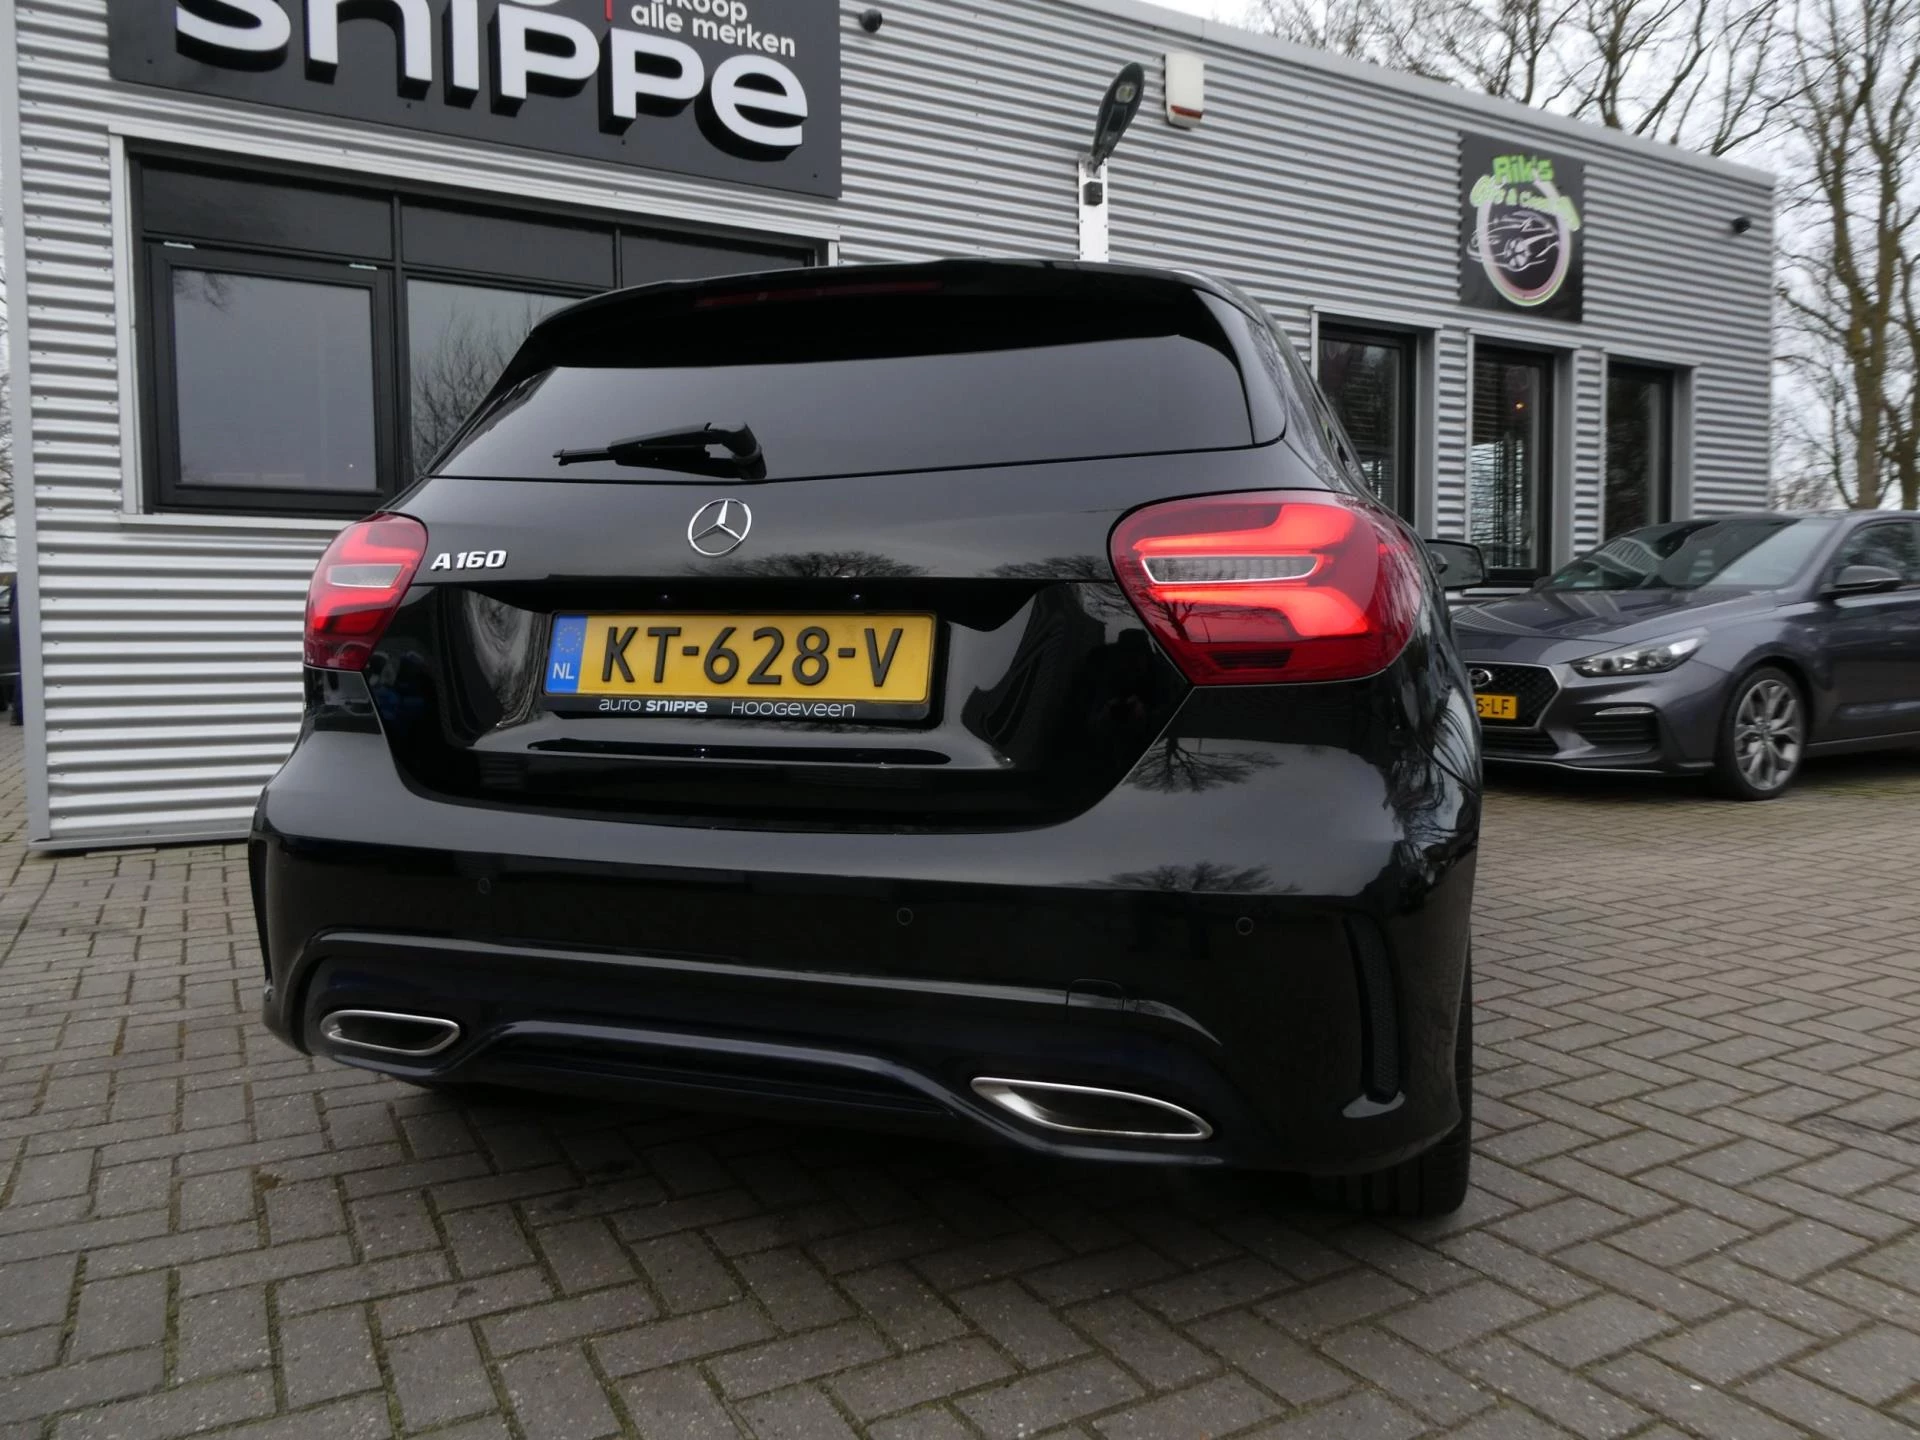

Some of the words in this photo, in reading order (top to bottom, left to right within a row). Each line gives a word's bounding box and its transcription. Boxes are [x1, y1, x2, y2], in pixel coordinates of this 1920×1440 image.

[631, 4, 683, 33] alle
[692, 17, 796, 57] merken
[430, 552, 451, 570] A
[456, 549, 507, 569] 160
[552, 661, 575, 680] NL
[602, 625, 903, 687] KT-628-V
